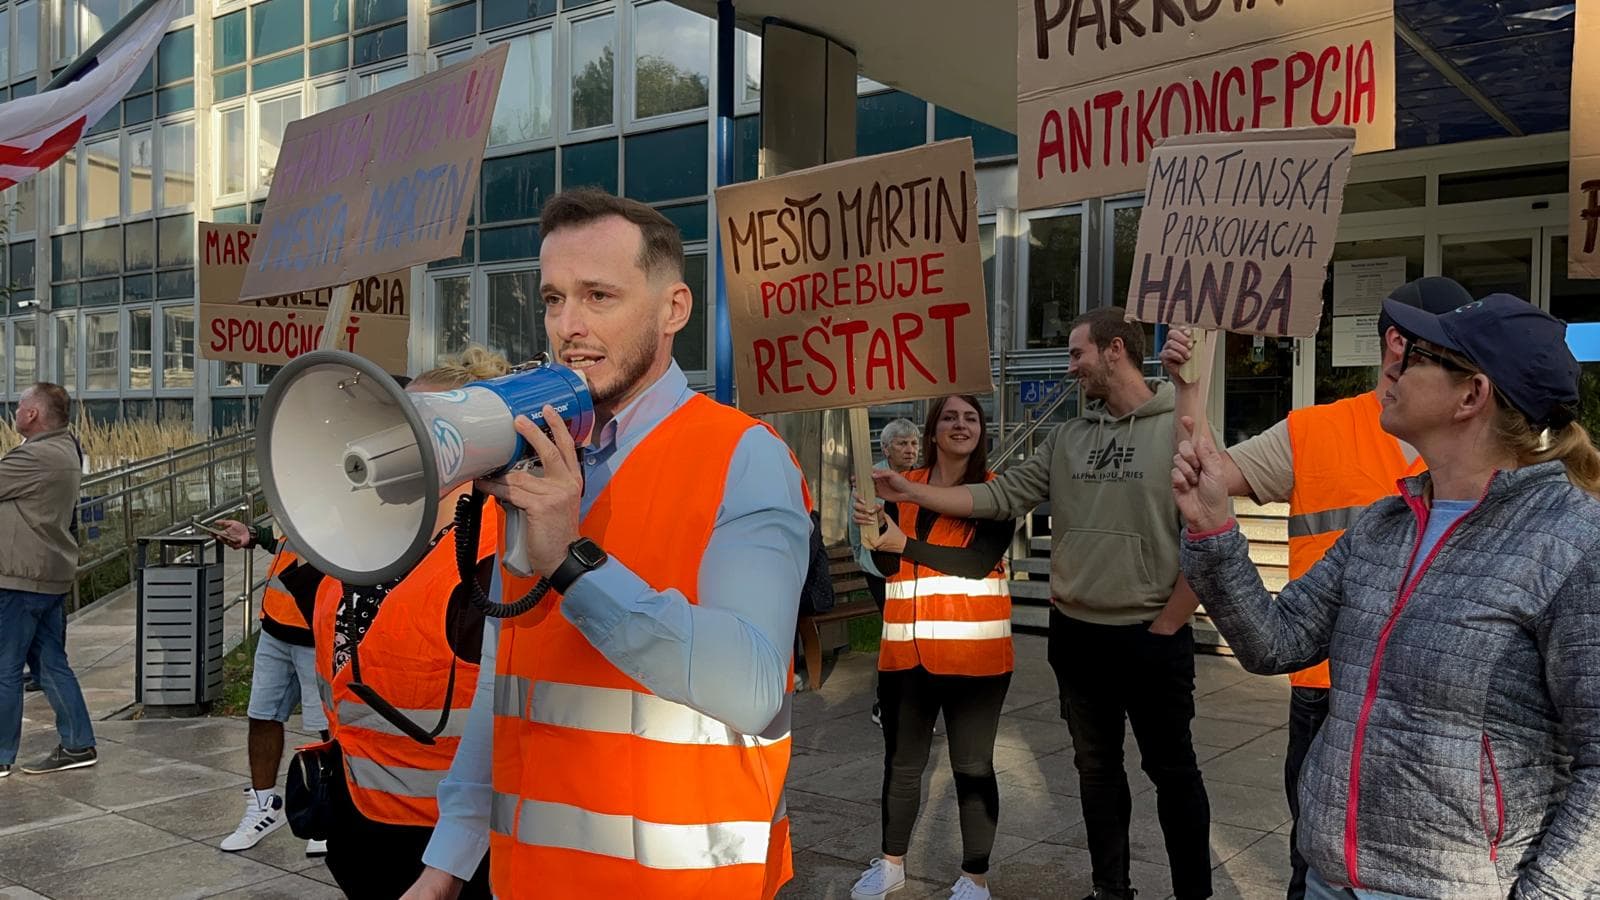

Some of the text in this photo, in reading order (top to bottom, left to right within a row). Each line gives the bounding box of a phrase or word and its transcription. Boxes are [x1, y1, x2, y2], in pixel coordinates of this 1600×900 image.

[1037, 39, 1376, 180] ANTIKONCEPCIA
[1147, 146, 1349, 214] MARTINSKÁ
[206, 229, 258, 265] MAR
[258, 158, 473, 273] MESTA MARTIN
[837, 170, 968, 261] MARTIN
[1160, 211, 1318, 260] PARKOVACIA
[760, 252, 945, 319] POTREBUJE
[1137, 253, 1293, 335] HANBA
[210, 312, 361, 359] SPOLOČNŤ
[531, 403, 568, 420] MOOR
[1072, 471, 1097, 480] ALPHA
